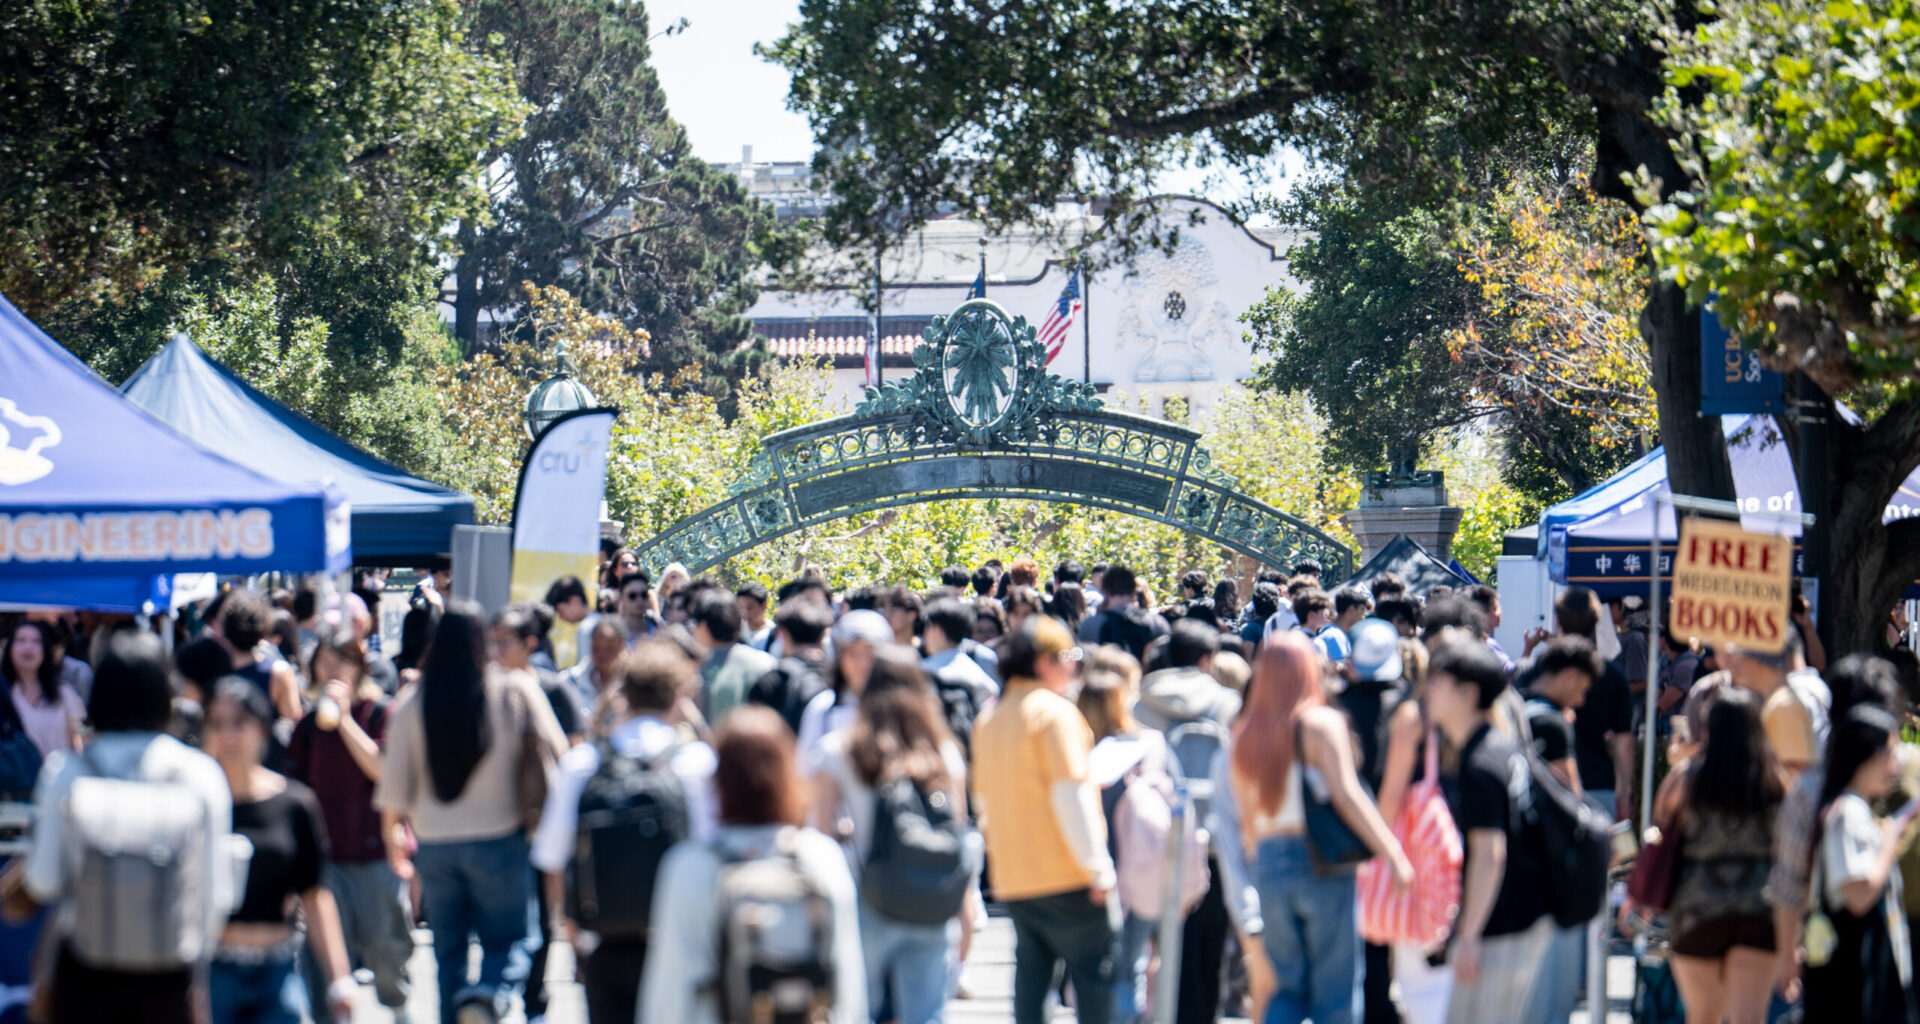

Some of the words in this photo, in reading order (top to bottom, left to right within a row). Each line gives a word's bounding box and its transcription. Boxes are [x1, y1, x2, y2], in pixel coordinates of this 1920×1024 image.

[1725, 351, 1742, 383] UC
[1767, 491, 1794, 512] of
[1688, 535, 1780, 577] FREE
[1676, 597, 1779, 641] BOOKS
